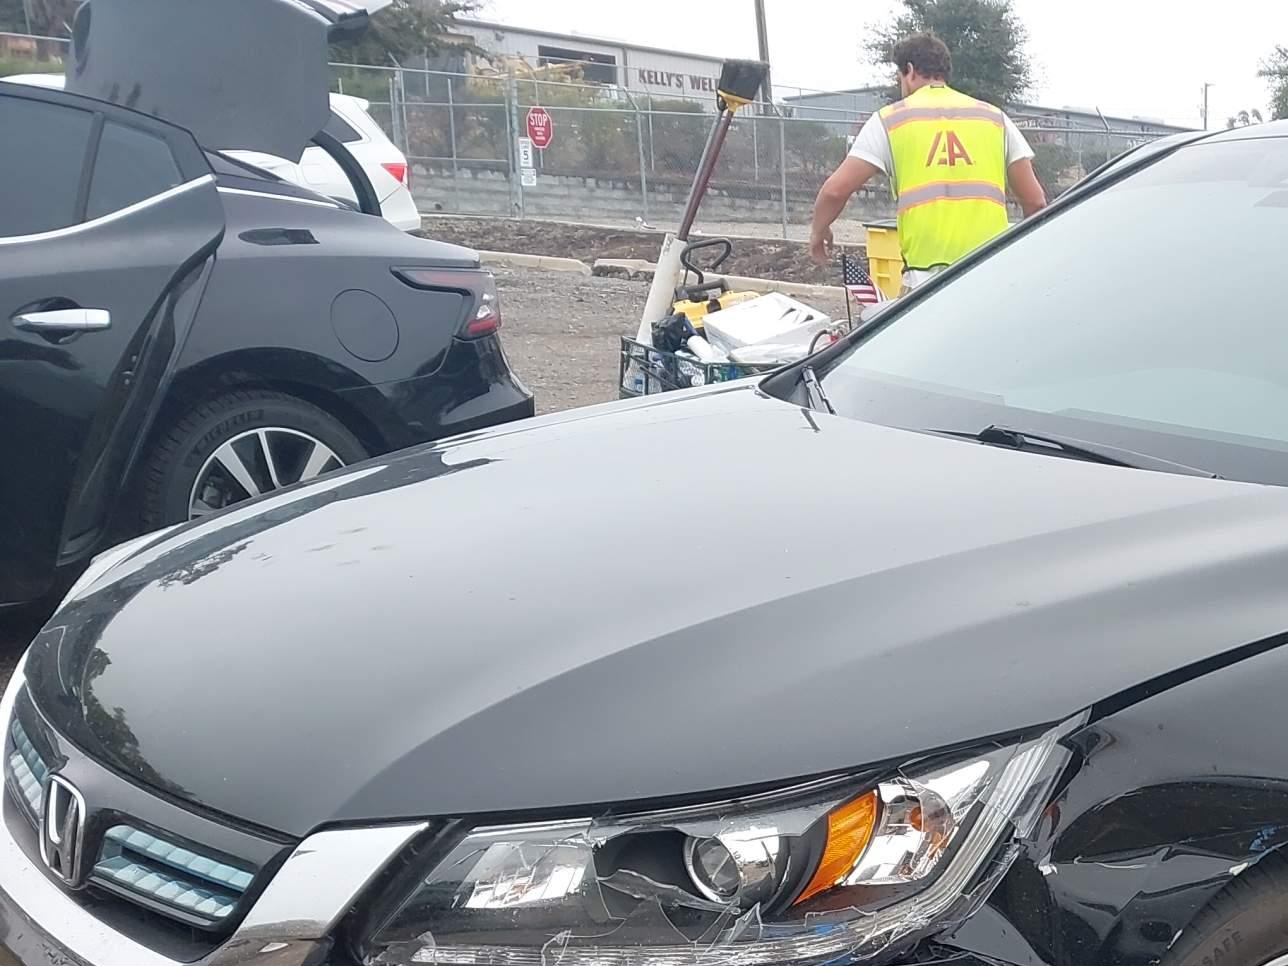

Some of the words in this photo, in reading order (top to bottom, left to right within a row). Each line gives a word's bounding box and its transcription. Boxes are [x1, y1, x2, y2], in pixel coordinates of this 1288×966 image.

[639, 69, 683, 88] KELLY'S
[529, 113, 548, 126] STOP
[523, 150, 529, 160] 5
